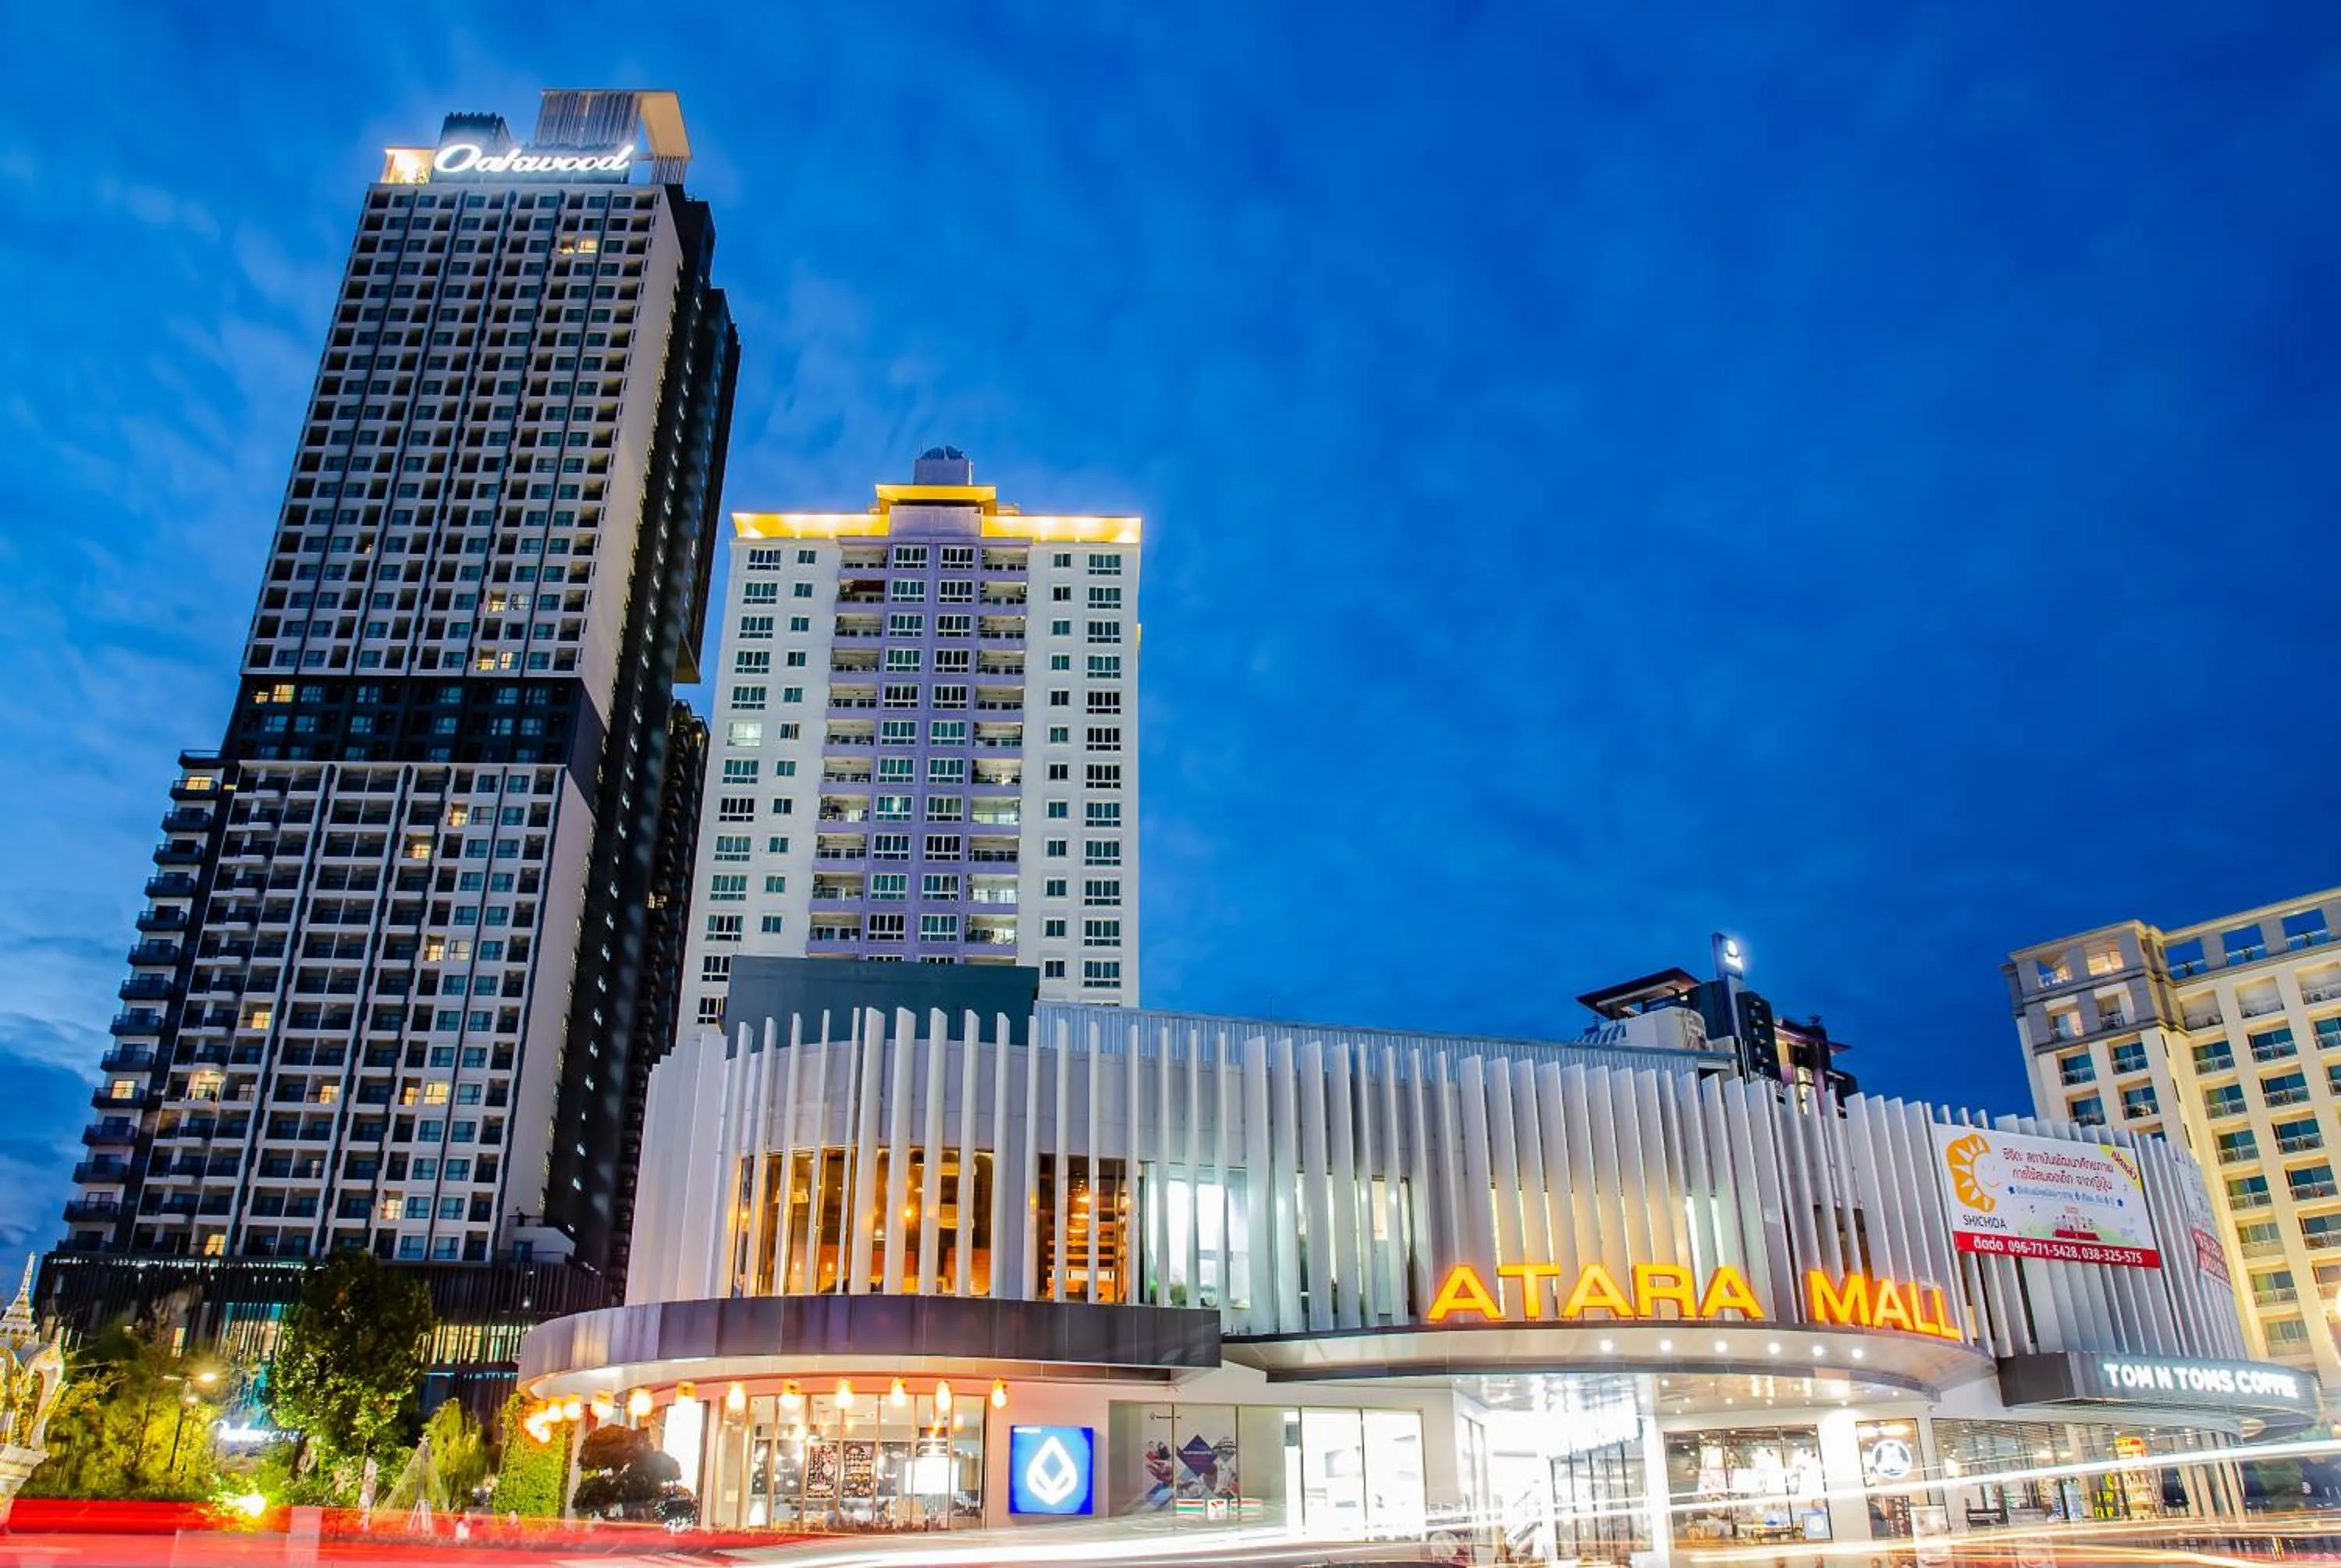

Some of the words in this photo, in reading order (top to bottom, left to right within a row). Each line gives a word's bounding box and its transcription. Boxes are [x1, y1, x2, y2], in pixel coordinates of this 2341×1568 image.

[434, 144, 634, 172] Oakwood
[1963, 1213, 2008, 1229] SHICHIDA
[1426, 1263, 1766, 1322] ATARA
[1807, 1270, 1962, 1340] MALL
[2104, 1364, 2155, 1389] TOM
[2155, 1366, 2173, 1390] N
[2173, 1367, 2236, 1393] TOMS
[2236, 1370, 2299, 1399] COFFEE
